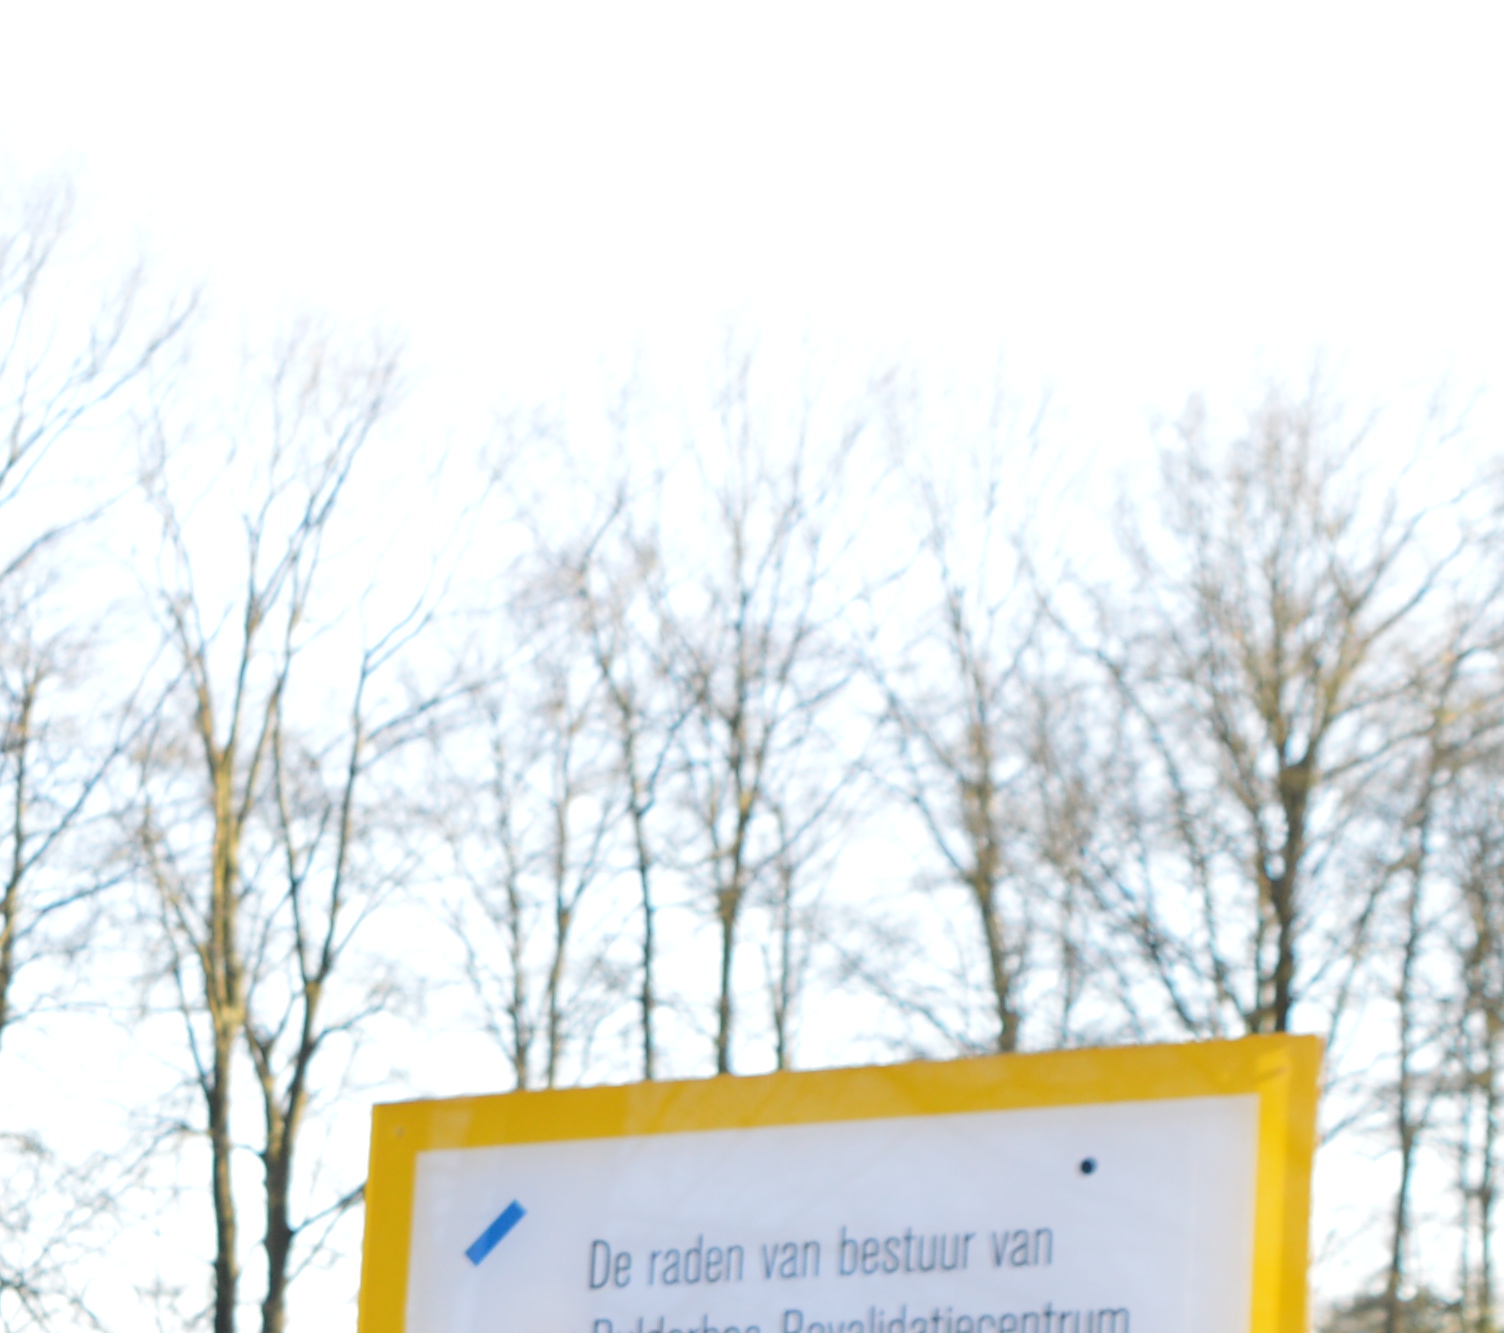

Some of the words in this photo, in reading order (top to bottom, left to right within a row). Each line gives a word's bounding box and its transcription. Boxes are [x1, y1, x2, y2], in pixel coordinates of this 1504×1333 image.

[587, 1239, 632, 1291] De
[648, 1234, 744, 1286] raden
[760, 1240, 821, 1280] van
[837, 1225, 975, 1277] bestuur
[990, 1227, 1053, 1268] van
